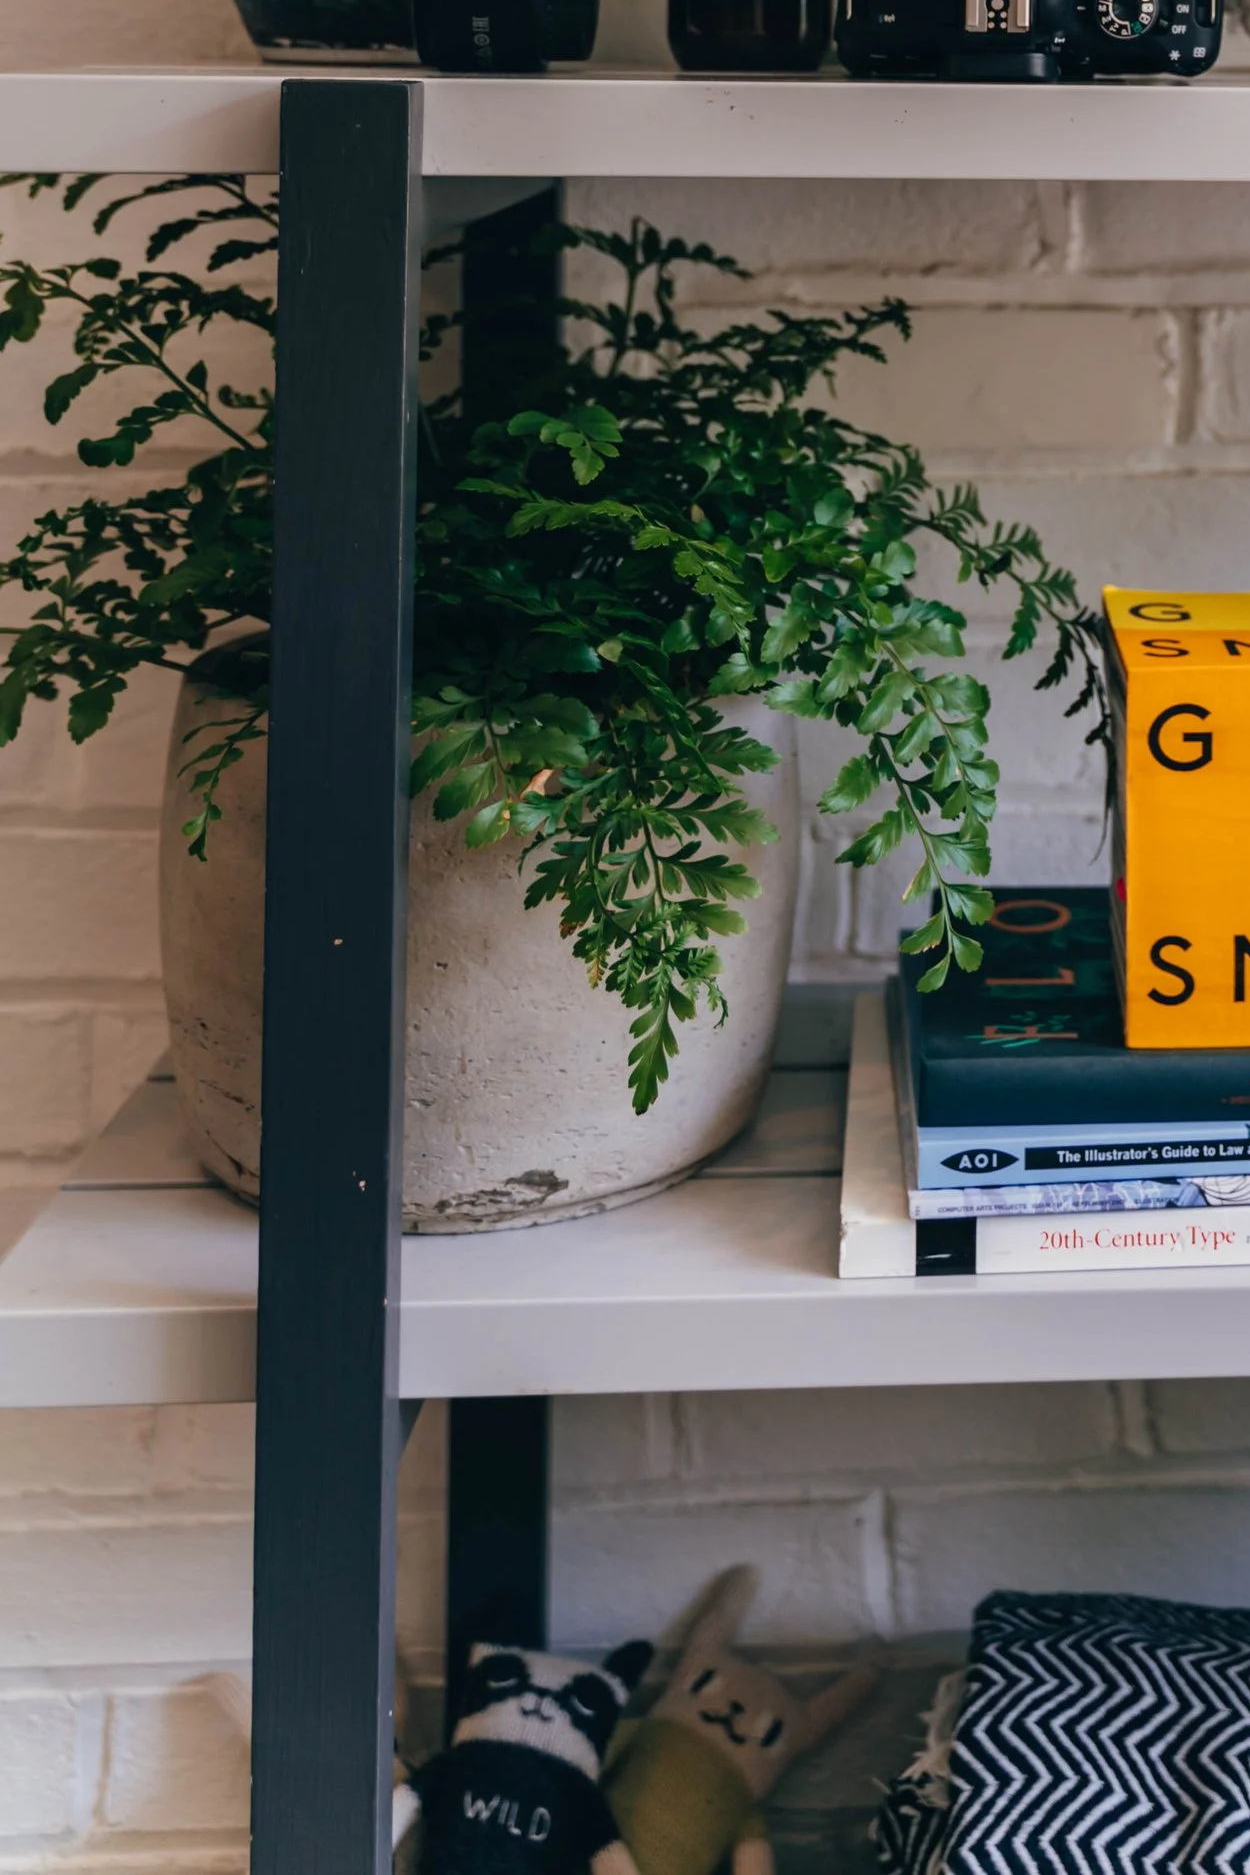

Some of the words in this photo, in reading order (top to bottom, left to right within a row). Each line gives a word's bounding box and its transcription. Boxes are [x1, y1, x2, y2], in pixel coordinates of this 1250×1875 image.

[1176, 4, 1190, 13] ON
[1171, 25, 1187, 34] OFF
[1147, 703, 1214, 772] G
[958, 1153, 998, 1169] AOI
[1057, 1150, 1081, 1163] The
[1162, 1145, 1200, 1159] Guide
[1203, 1145, 1216, 1157] to
[1219, 1143, 1244, 1156] Law
[1039, 1227, 1181, 1253] 20th-Century
[1185, 1224, 1236, 1251] Type
[463, 1790, 552, 1842] WILD
